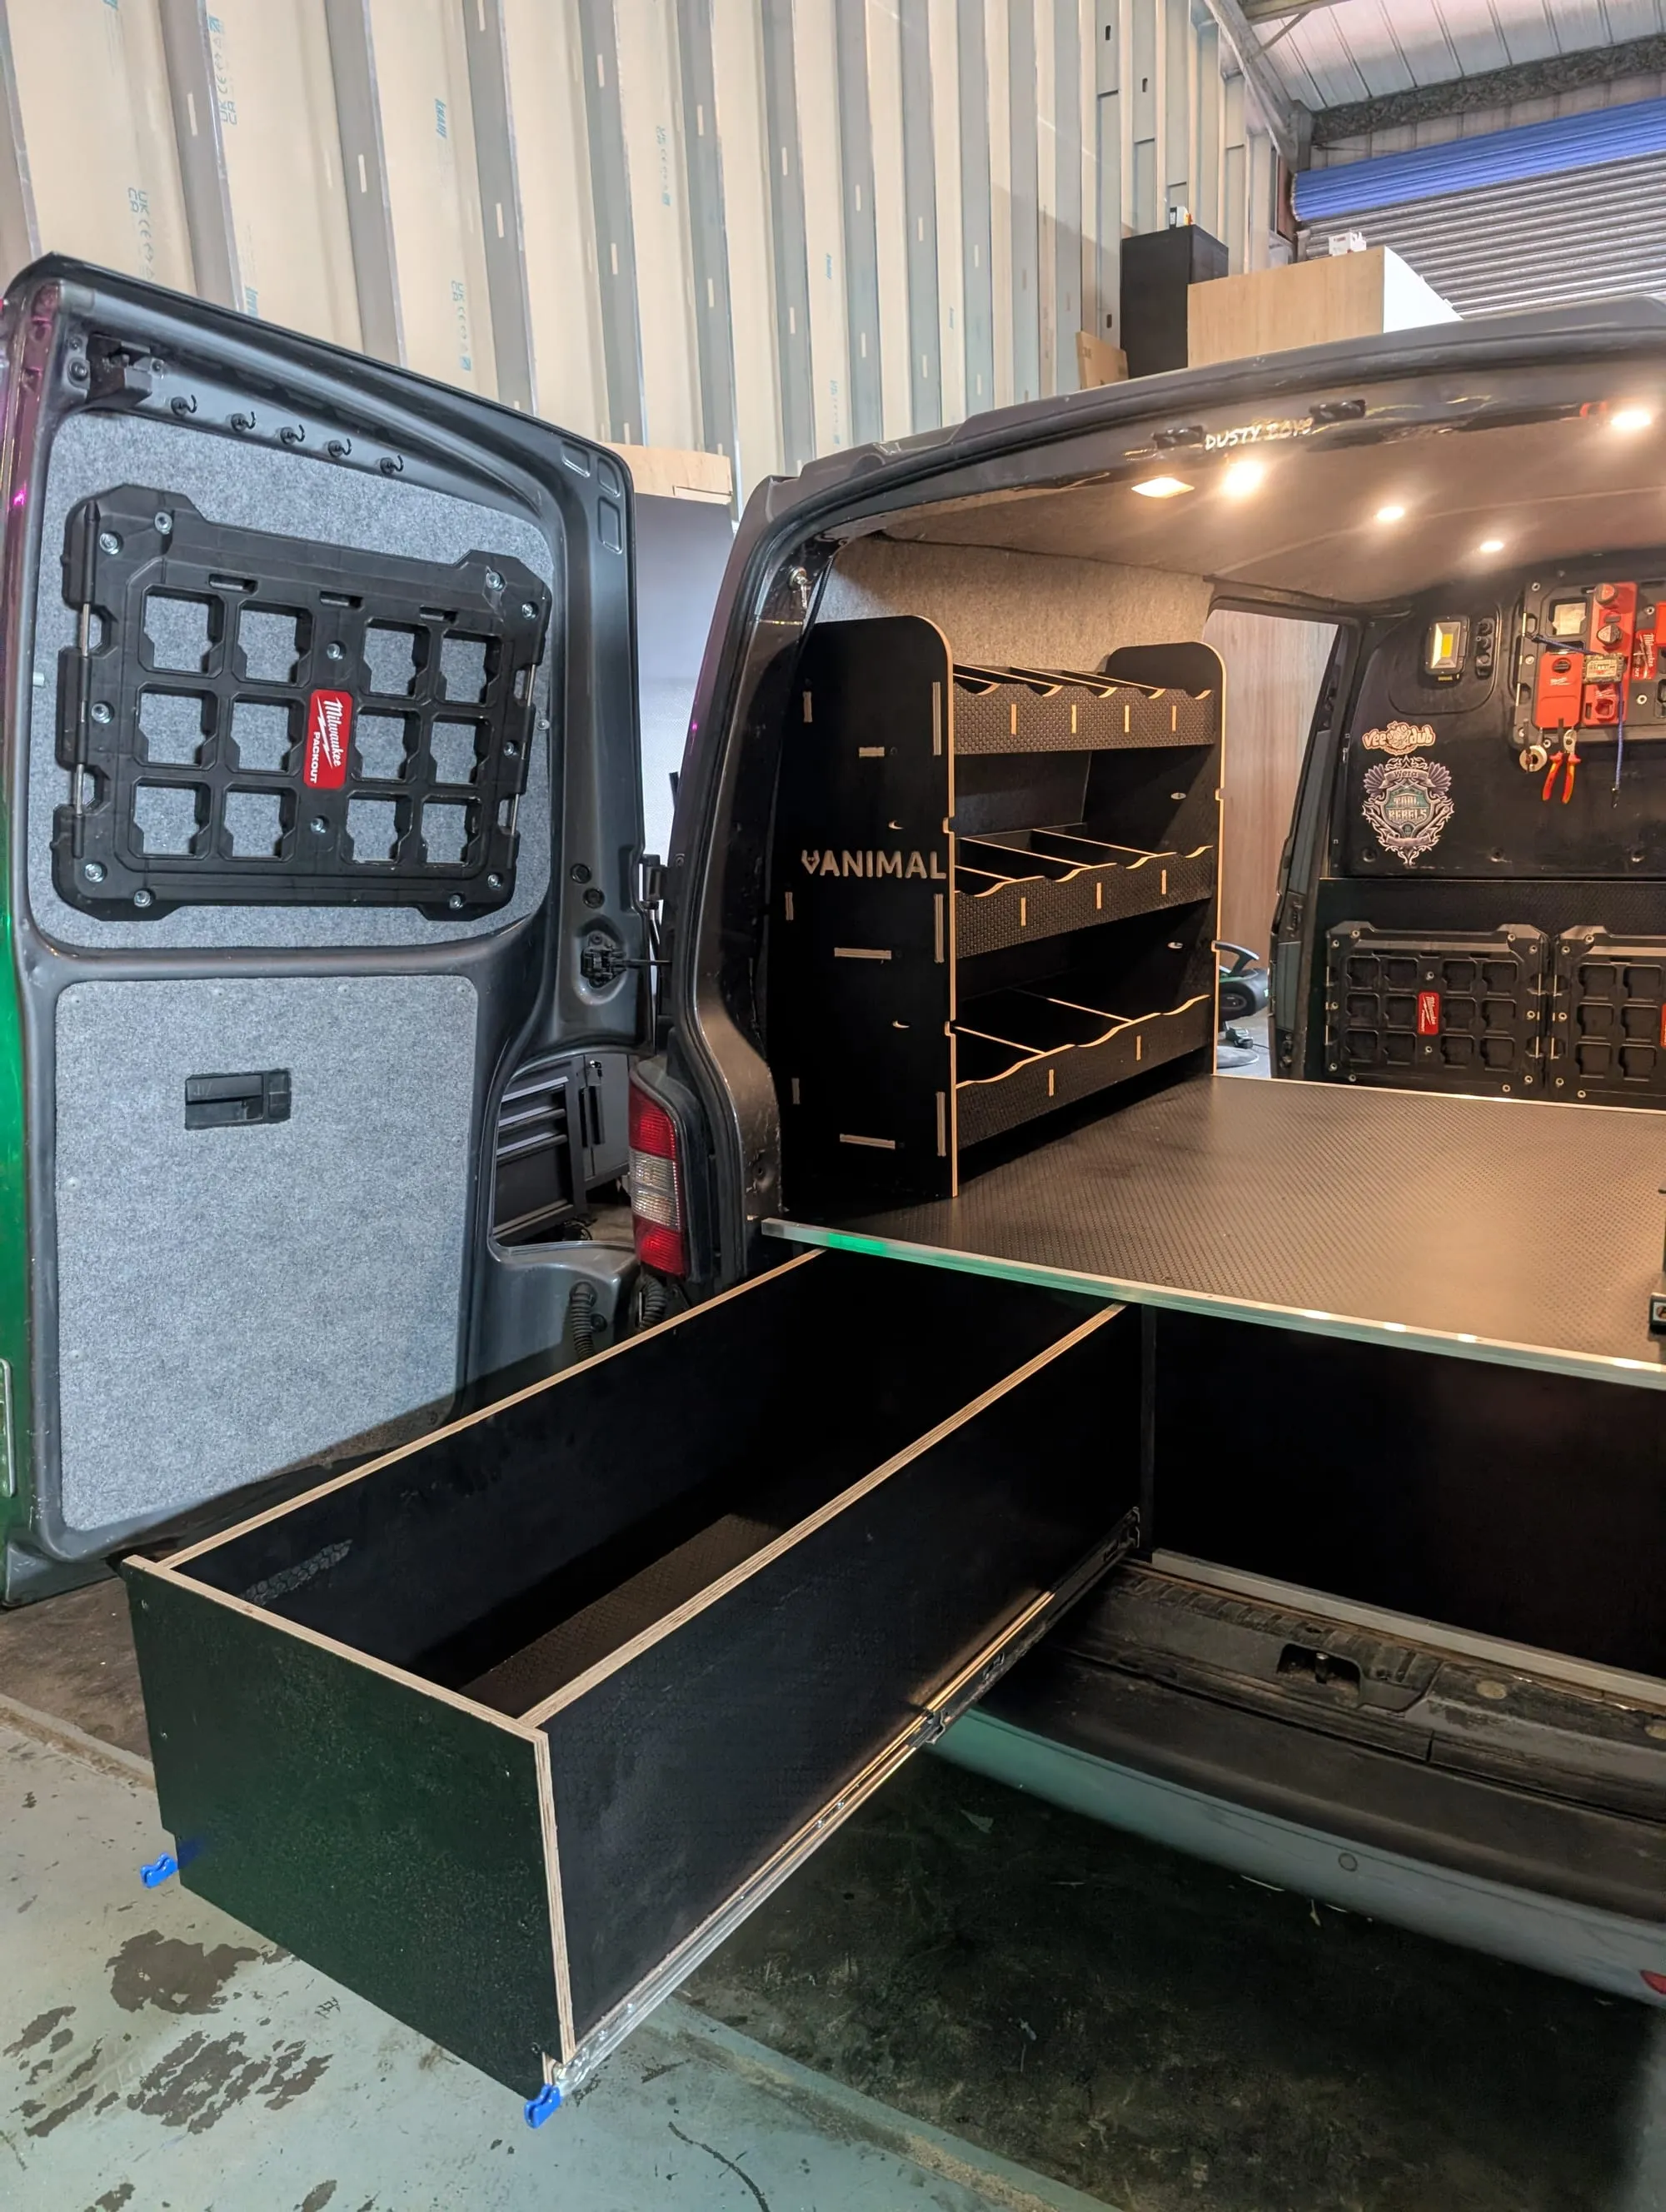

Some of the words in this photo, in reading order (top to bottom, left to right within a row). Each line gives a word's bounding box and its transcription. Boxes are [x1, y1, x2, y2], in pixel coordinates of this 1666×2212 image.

[1205, 424, 1262, 451] DUSTY
[323, 697, 344, 767] Milwaukee
[310, 731, 321, 784] PACKOUT
[1388, 809, 1428, 821] REBELS
